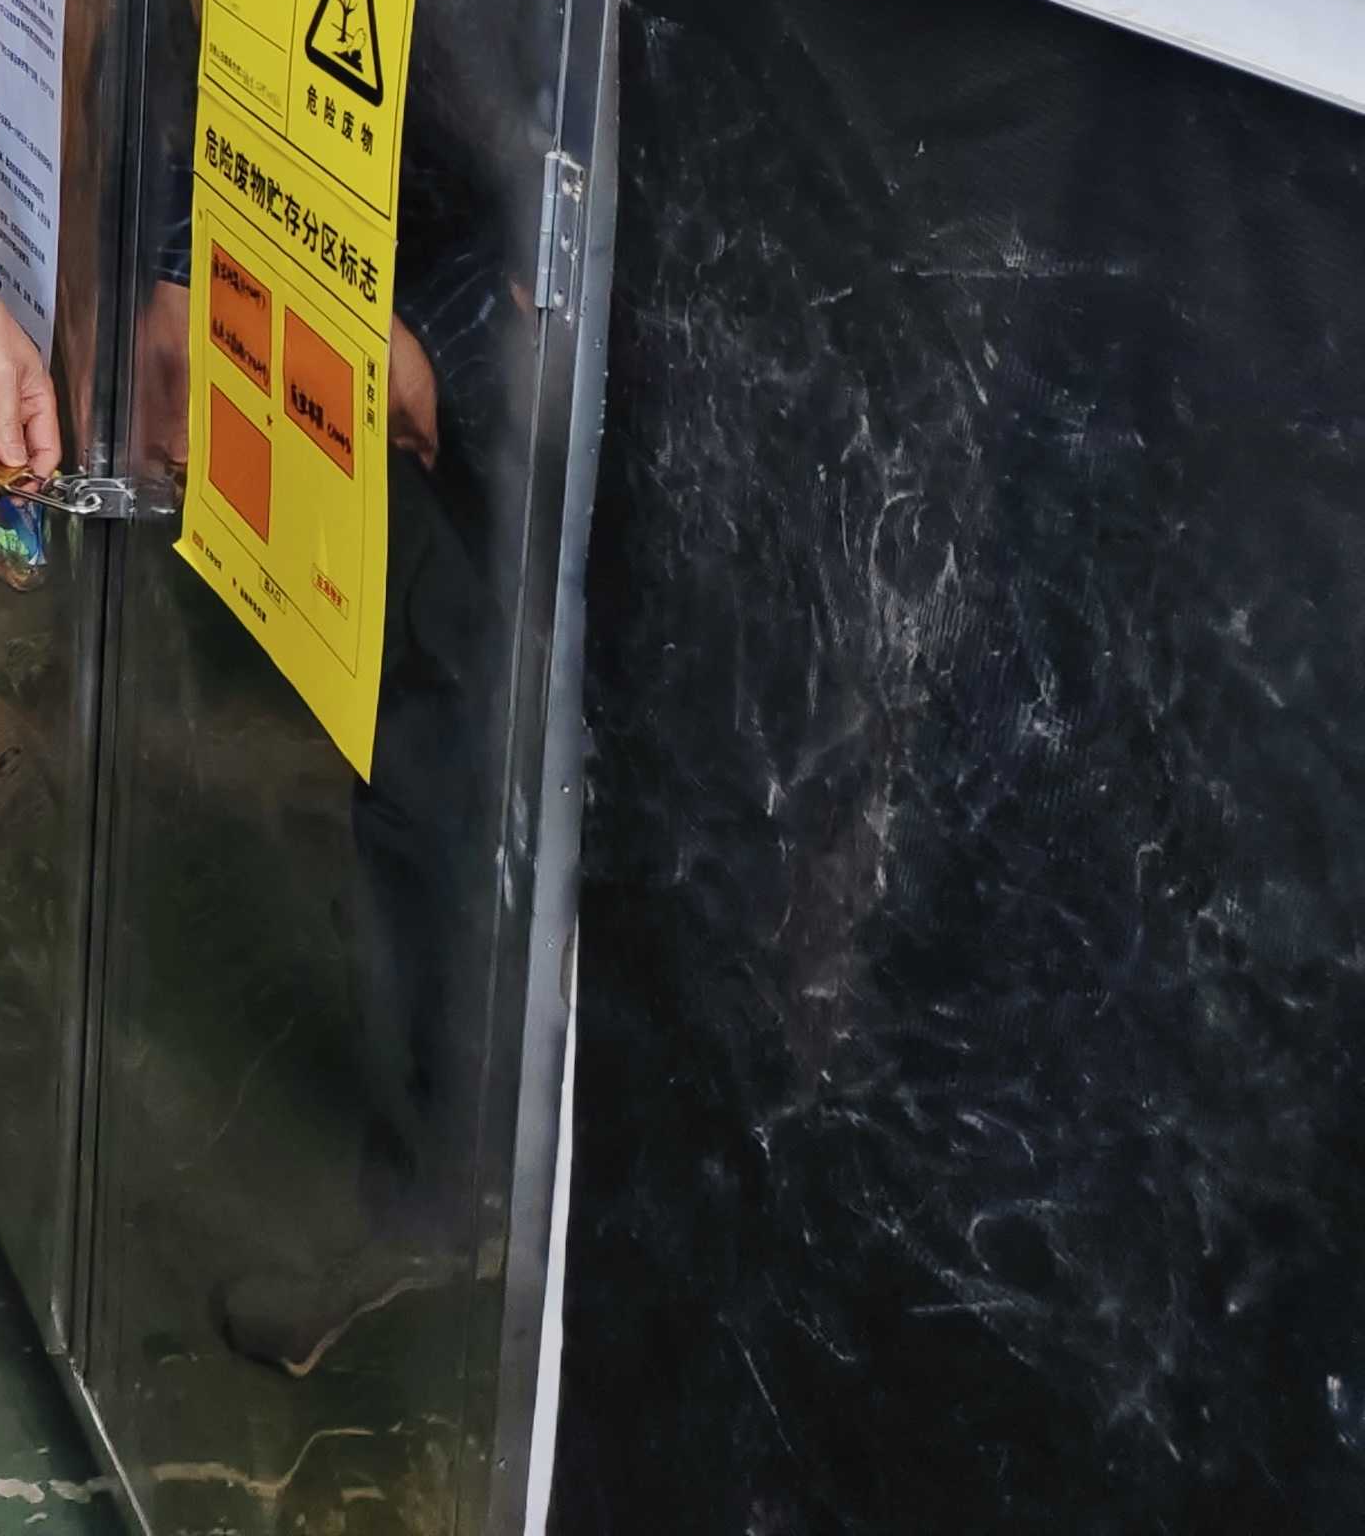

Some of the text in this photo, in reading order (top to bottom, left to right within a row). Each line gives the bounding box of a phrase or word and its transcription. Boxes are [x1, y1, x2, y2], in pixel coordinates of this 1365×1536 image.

[306, 85, 374, 156] 危险废物
[205, 124, 378, 304] 危险废物贮存分区标志
